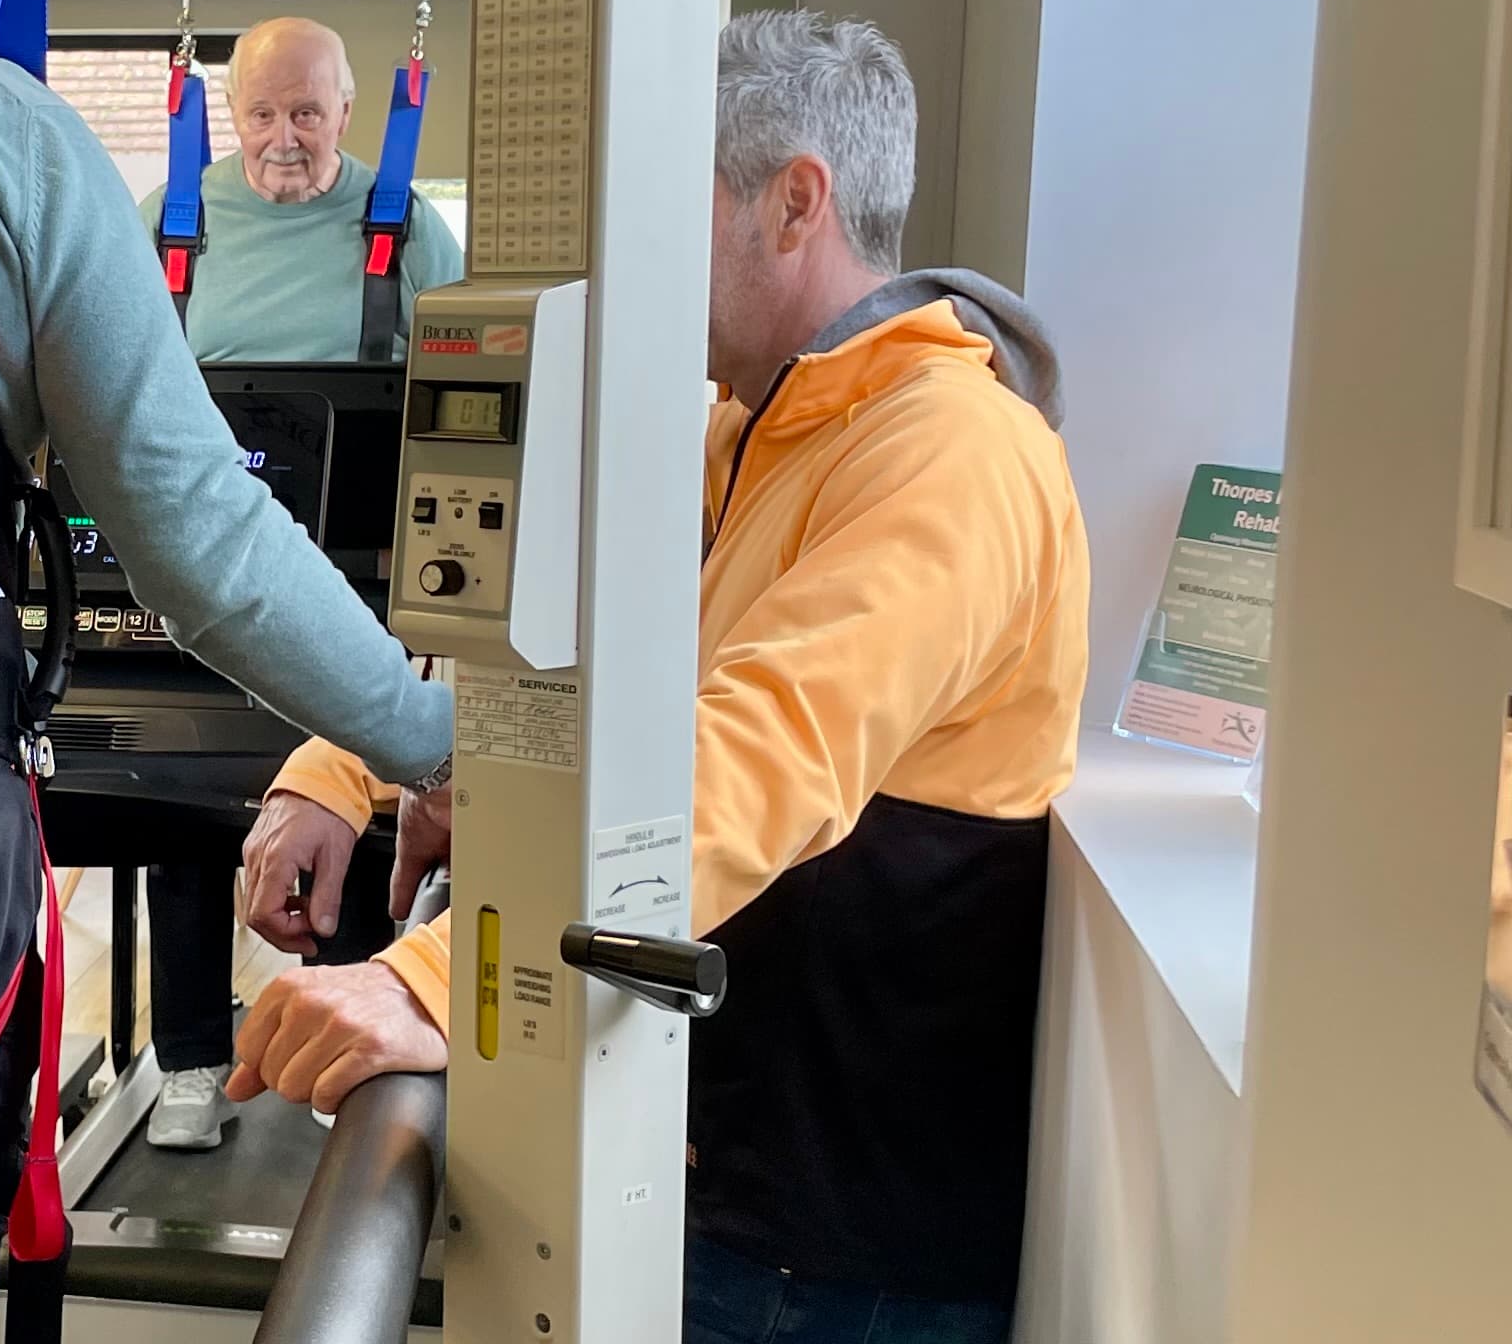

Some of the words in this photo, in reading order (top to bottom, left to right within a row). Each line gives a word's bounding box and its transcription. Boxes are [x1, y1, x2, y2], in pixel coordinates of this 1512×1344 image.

[423, 325, 476, 340] BIODEX
[423, 342, 475, 352] MEDICAL
[1211, 478, 1273, 504] Thorpes
[129, 615, 142, 626] 12
[518, 678, 577, 694] SERVICED
[653, 891, 681, 906] INCREASE
[595, 903, 626, 918] DECREASE
